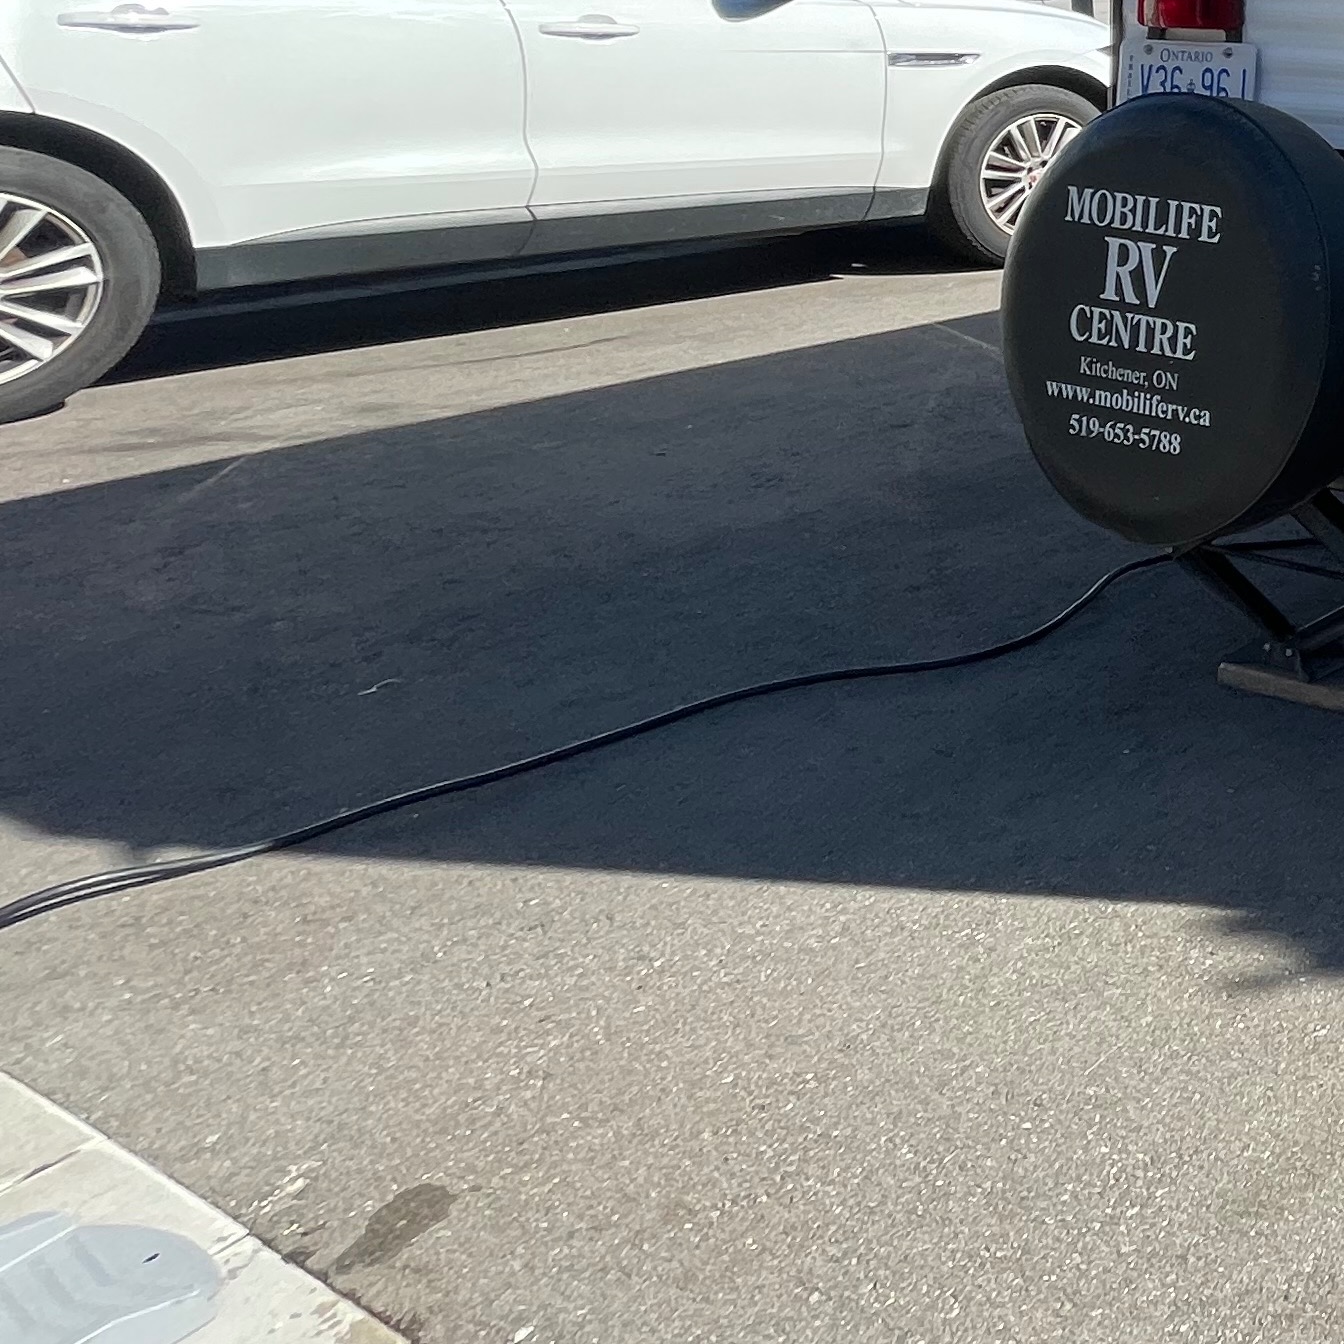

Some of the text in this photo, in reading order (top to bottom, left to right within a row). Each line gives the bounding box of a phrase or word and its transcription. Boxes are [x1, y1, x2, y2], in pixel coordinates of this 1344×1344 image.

[1064, 185, 1223, 244] MOBILIFE
[1099, 236, 1178, 309] RV
[1069, 304, 1198, 361] CENTRE
[1079, 356, 1179, 391] Kitchener, ON
[1045, 379, 1212, 427] www.mobiliferv.ca
[1068, 414, 1182, 455] 519-653-5788
